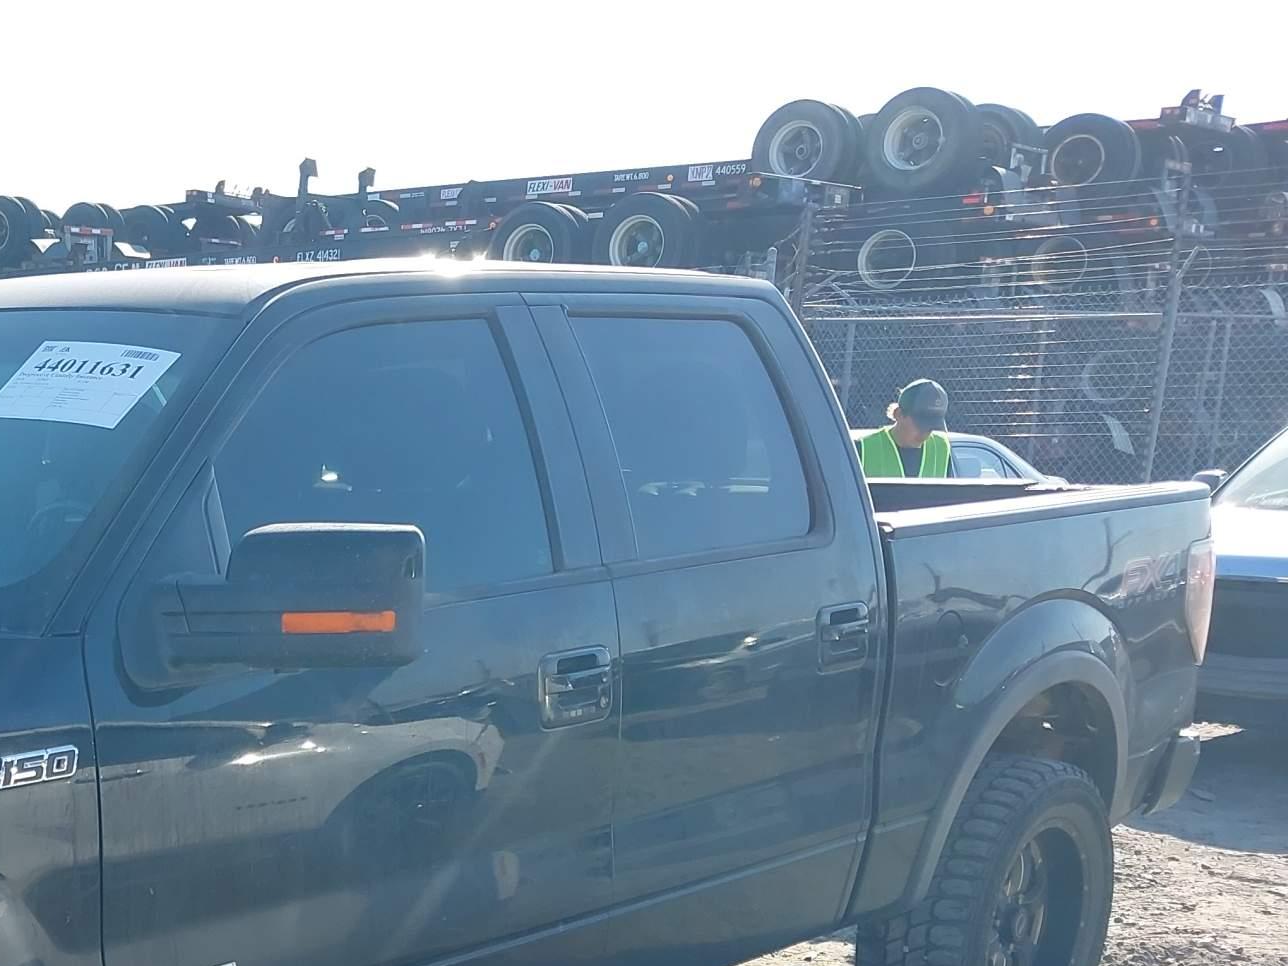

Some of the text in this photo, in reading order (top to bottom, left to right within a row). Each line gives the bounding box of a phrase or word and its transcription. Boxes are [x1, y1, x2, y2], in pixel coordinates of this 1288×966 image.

[715, 164, 746, 175] 440559
[528, 179, 571, 193] FLEXI-VAN
[34, 358, 145, 379] 44011631
